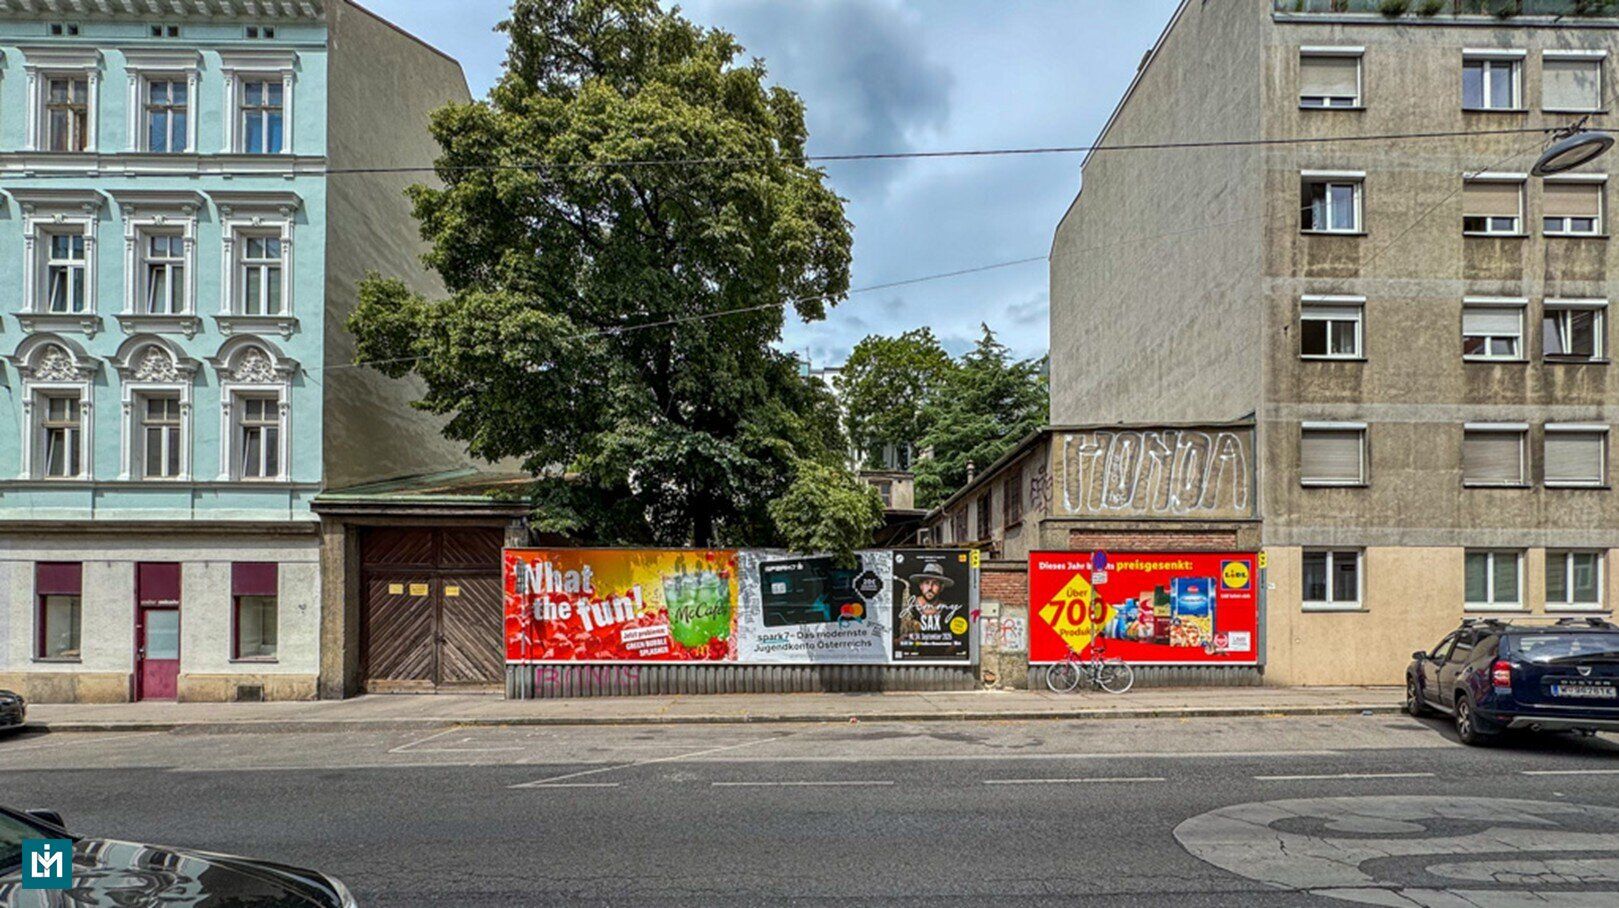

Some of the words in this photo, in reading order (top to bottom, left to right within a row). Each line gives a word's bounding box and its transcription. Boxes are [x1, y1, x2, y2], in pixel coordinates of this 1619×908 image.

[1063, 430, 1246, 513] HONDA
[1038, 561, 1066, 570] Dieses
[1067, 561, 1085, 570] Jahr
[1116, 559, 1193, 572] preisgesenkt:
[1067, 587, 1087, 597] Über
[533, 595, 572, 620] the
[576, 585, 645, 632] fun!
[1049, 597, 1107, 627] 700
[920, 614, 941, 631] SAX
[797, 631, 815, 639] Das
[817, 629, 867, 638] modernste
[1059, 627, 1100, 636] Produk
[754, 644, 815, 653] Jugendkonto
[817, 638, 872, 649] Österreichs
